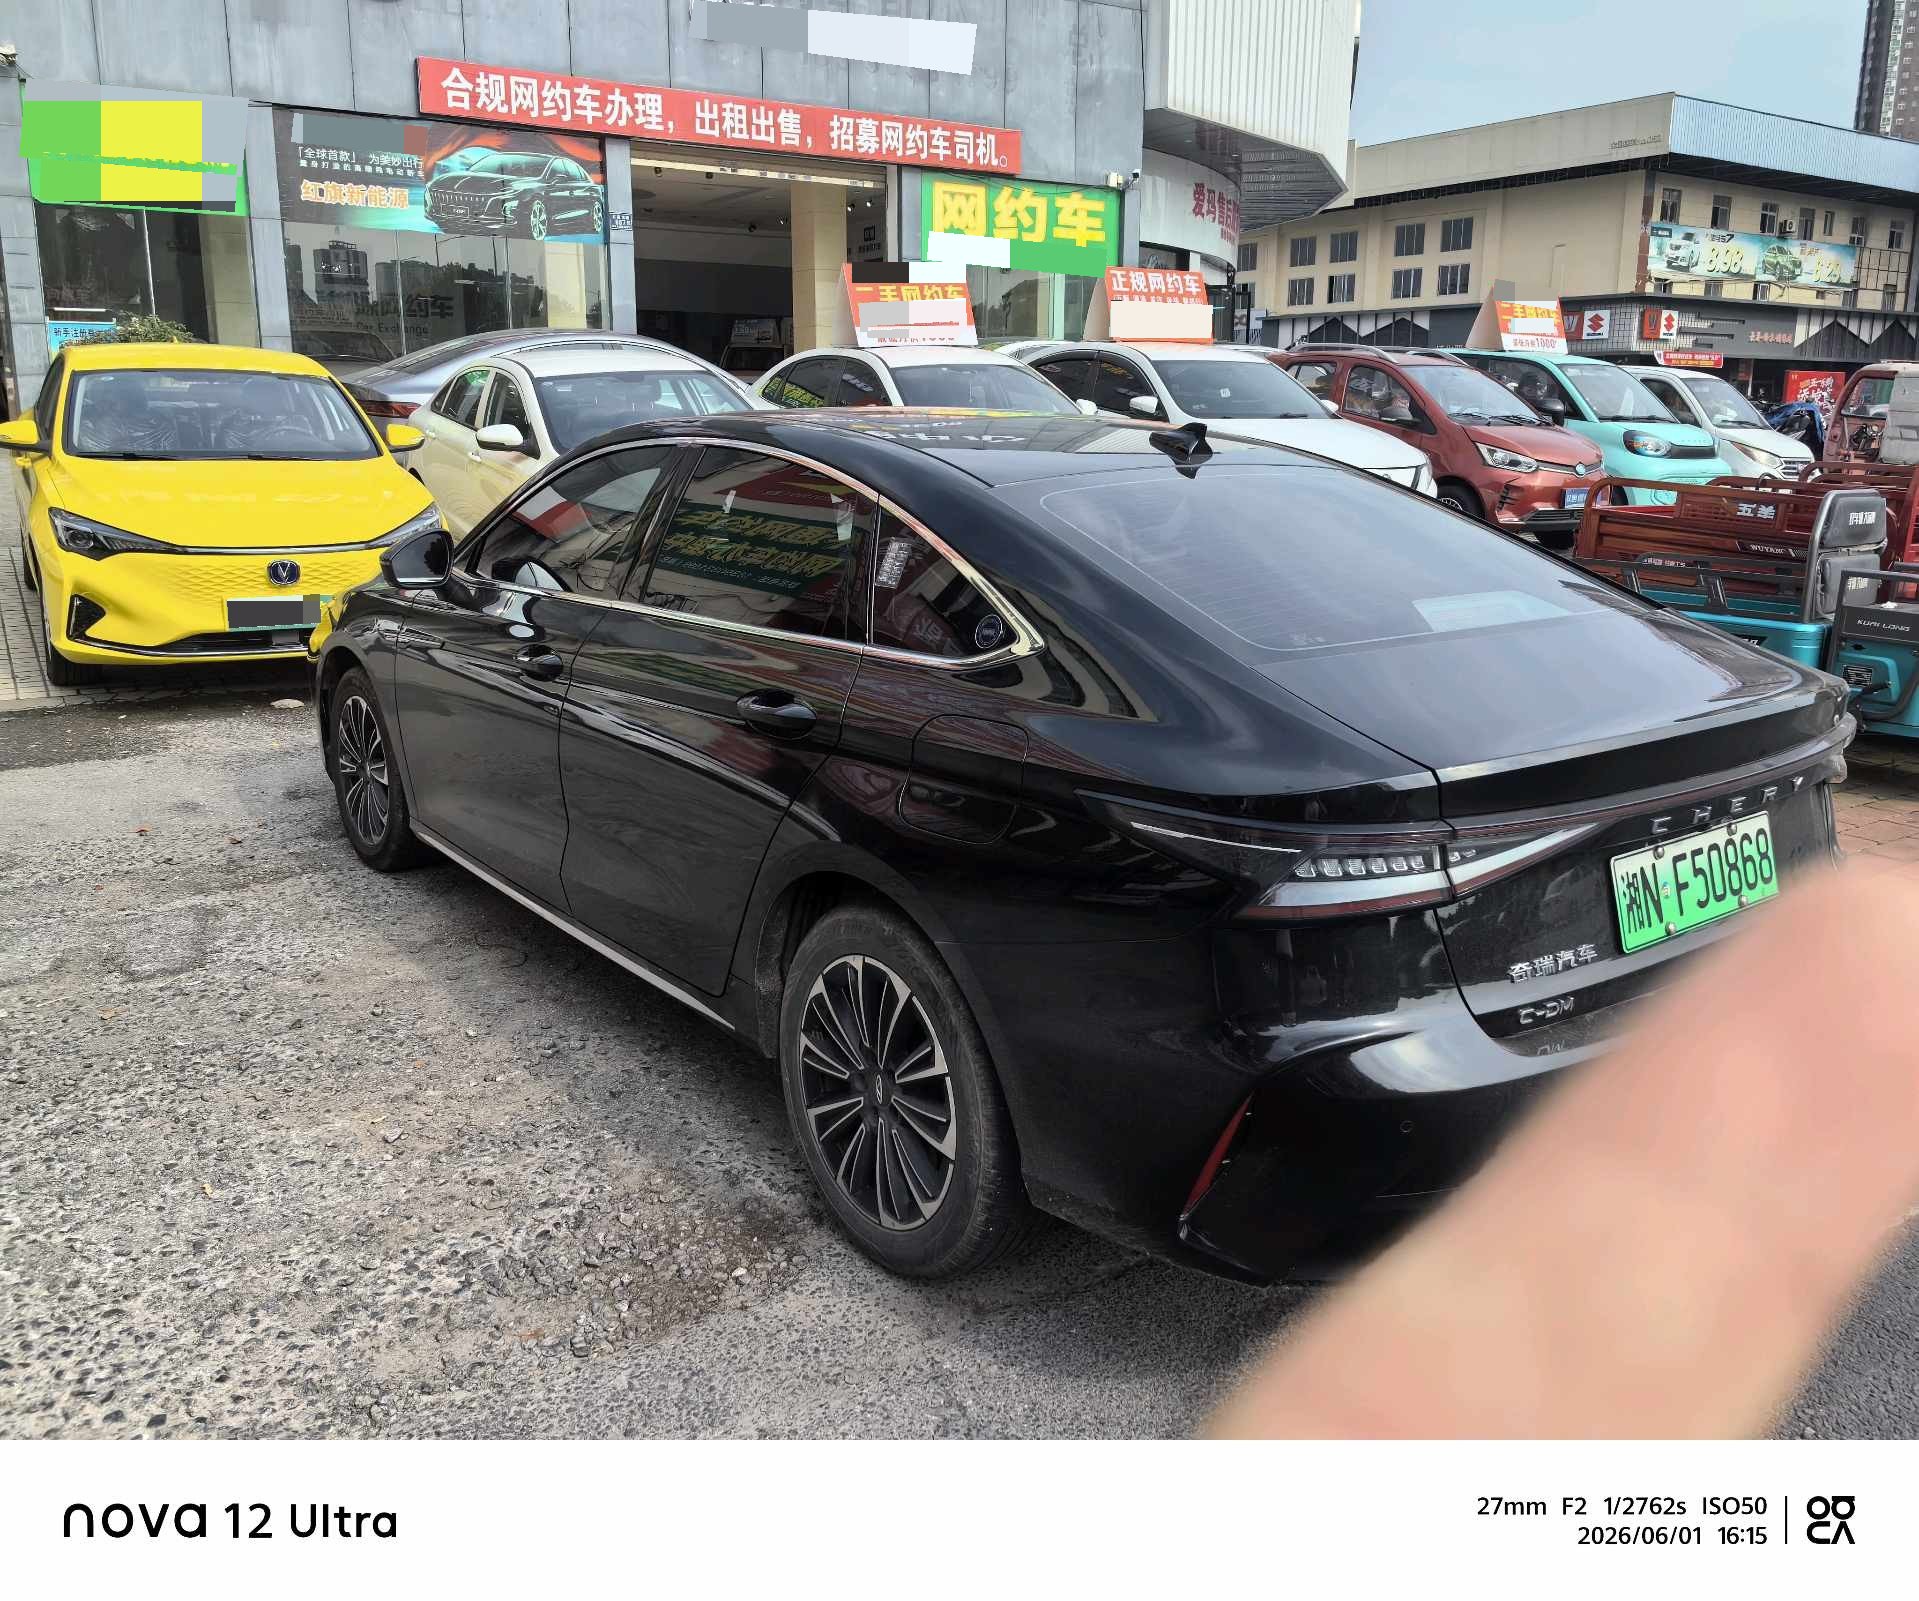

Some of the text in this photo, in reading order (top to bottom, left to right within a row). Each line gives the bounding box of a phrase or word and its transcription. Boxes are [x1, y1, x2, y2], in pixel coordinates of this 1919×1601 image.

[301, 179, 409, 209] 红旗新能源
[933, 177, 1106, 247] 网约车
[1110, 269, 1202, 295] 正规网约车
[1650, 777, 1804, 835] CHERY
[1508, 944, 1598, 983] 奇瑞汽车
[1519, 996, 1575, 1025] C-DM
